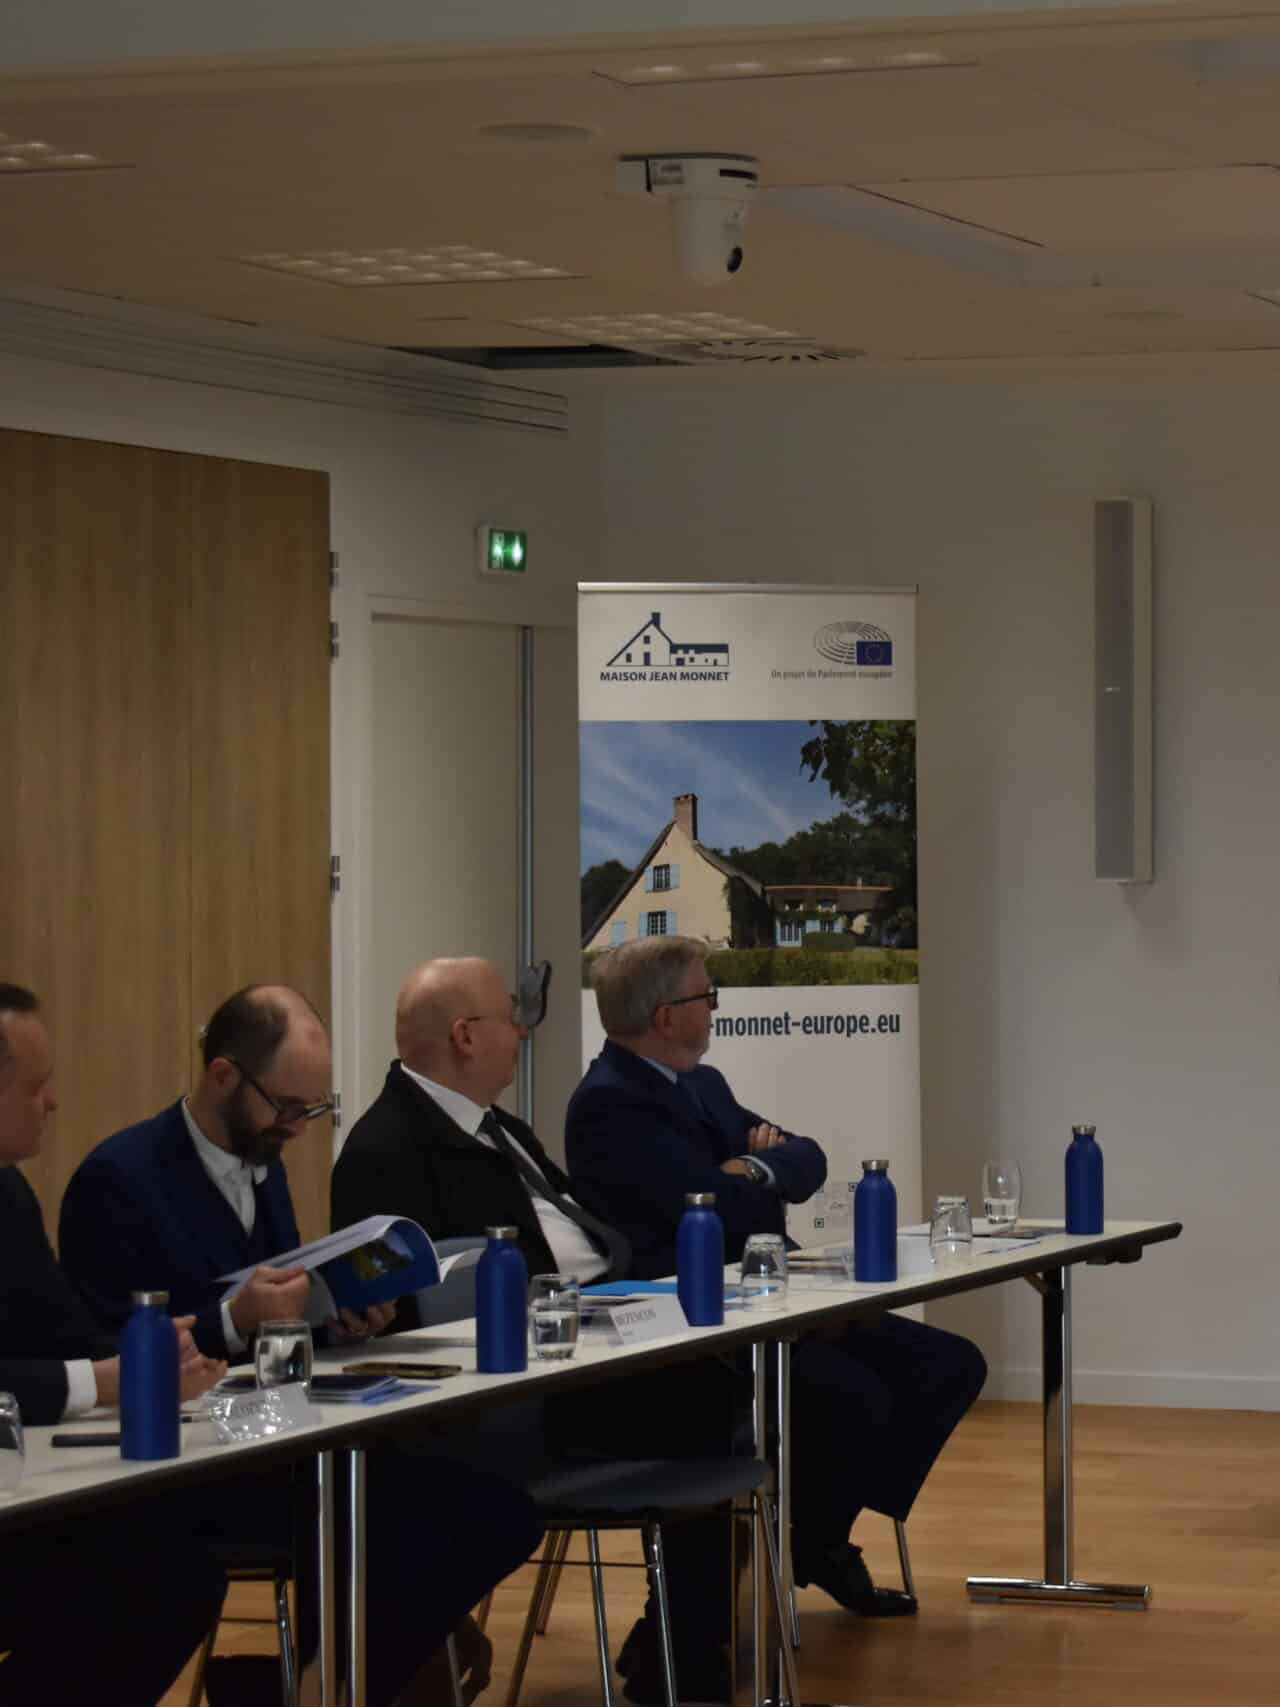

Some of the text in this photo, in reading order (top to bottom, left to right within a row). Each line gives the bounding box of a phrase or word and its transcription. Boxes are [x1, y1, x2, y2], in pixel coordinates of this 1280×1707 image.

[600, 671, 729, 681] MAISON JEAN MONNET
